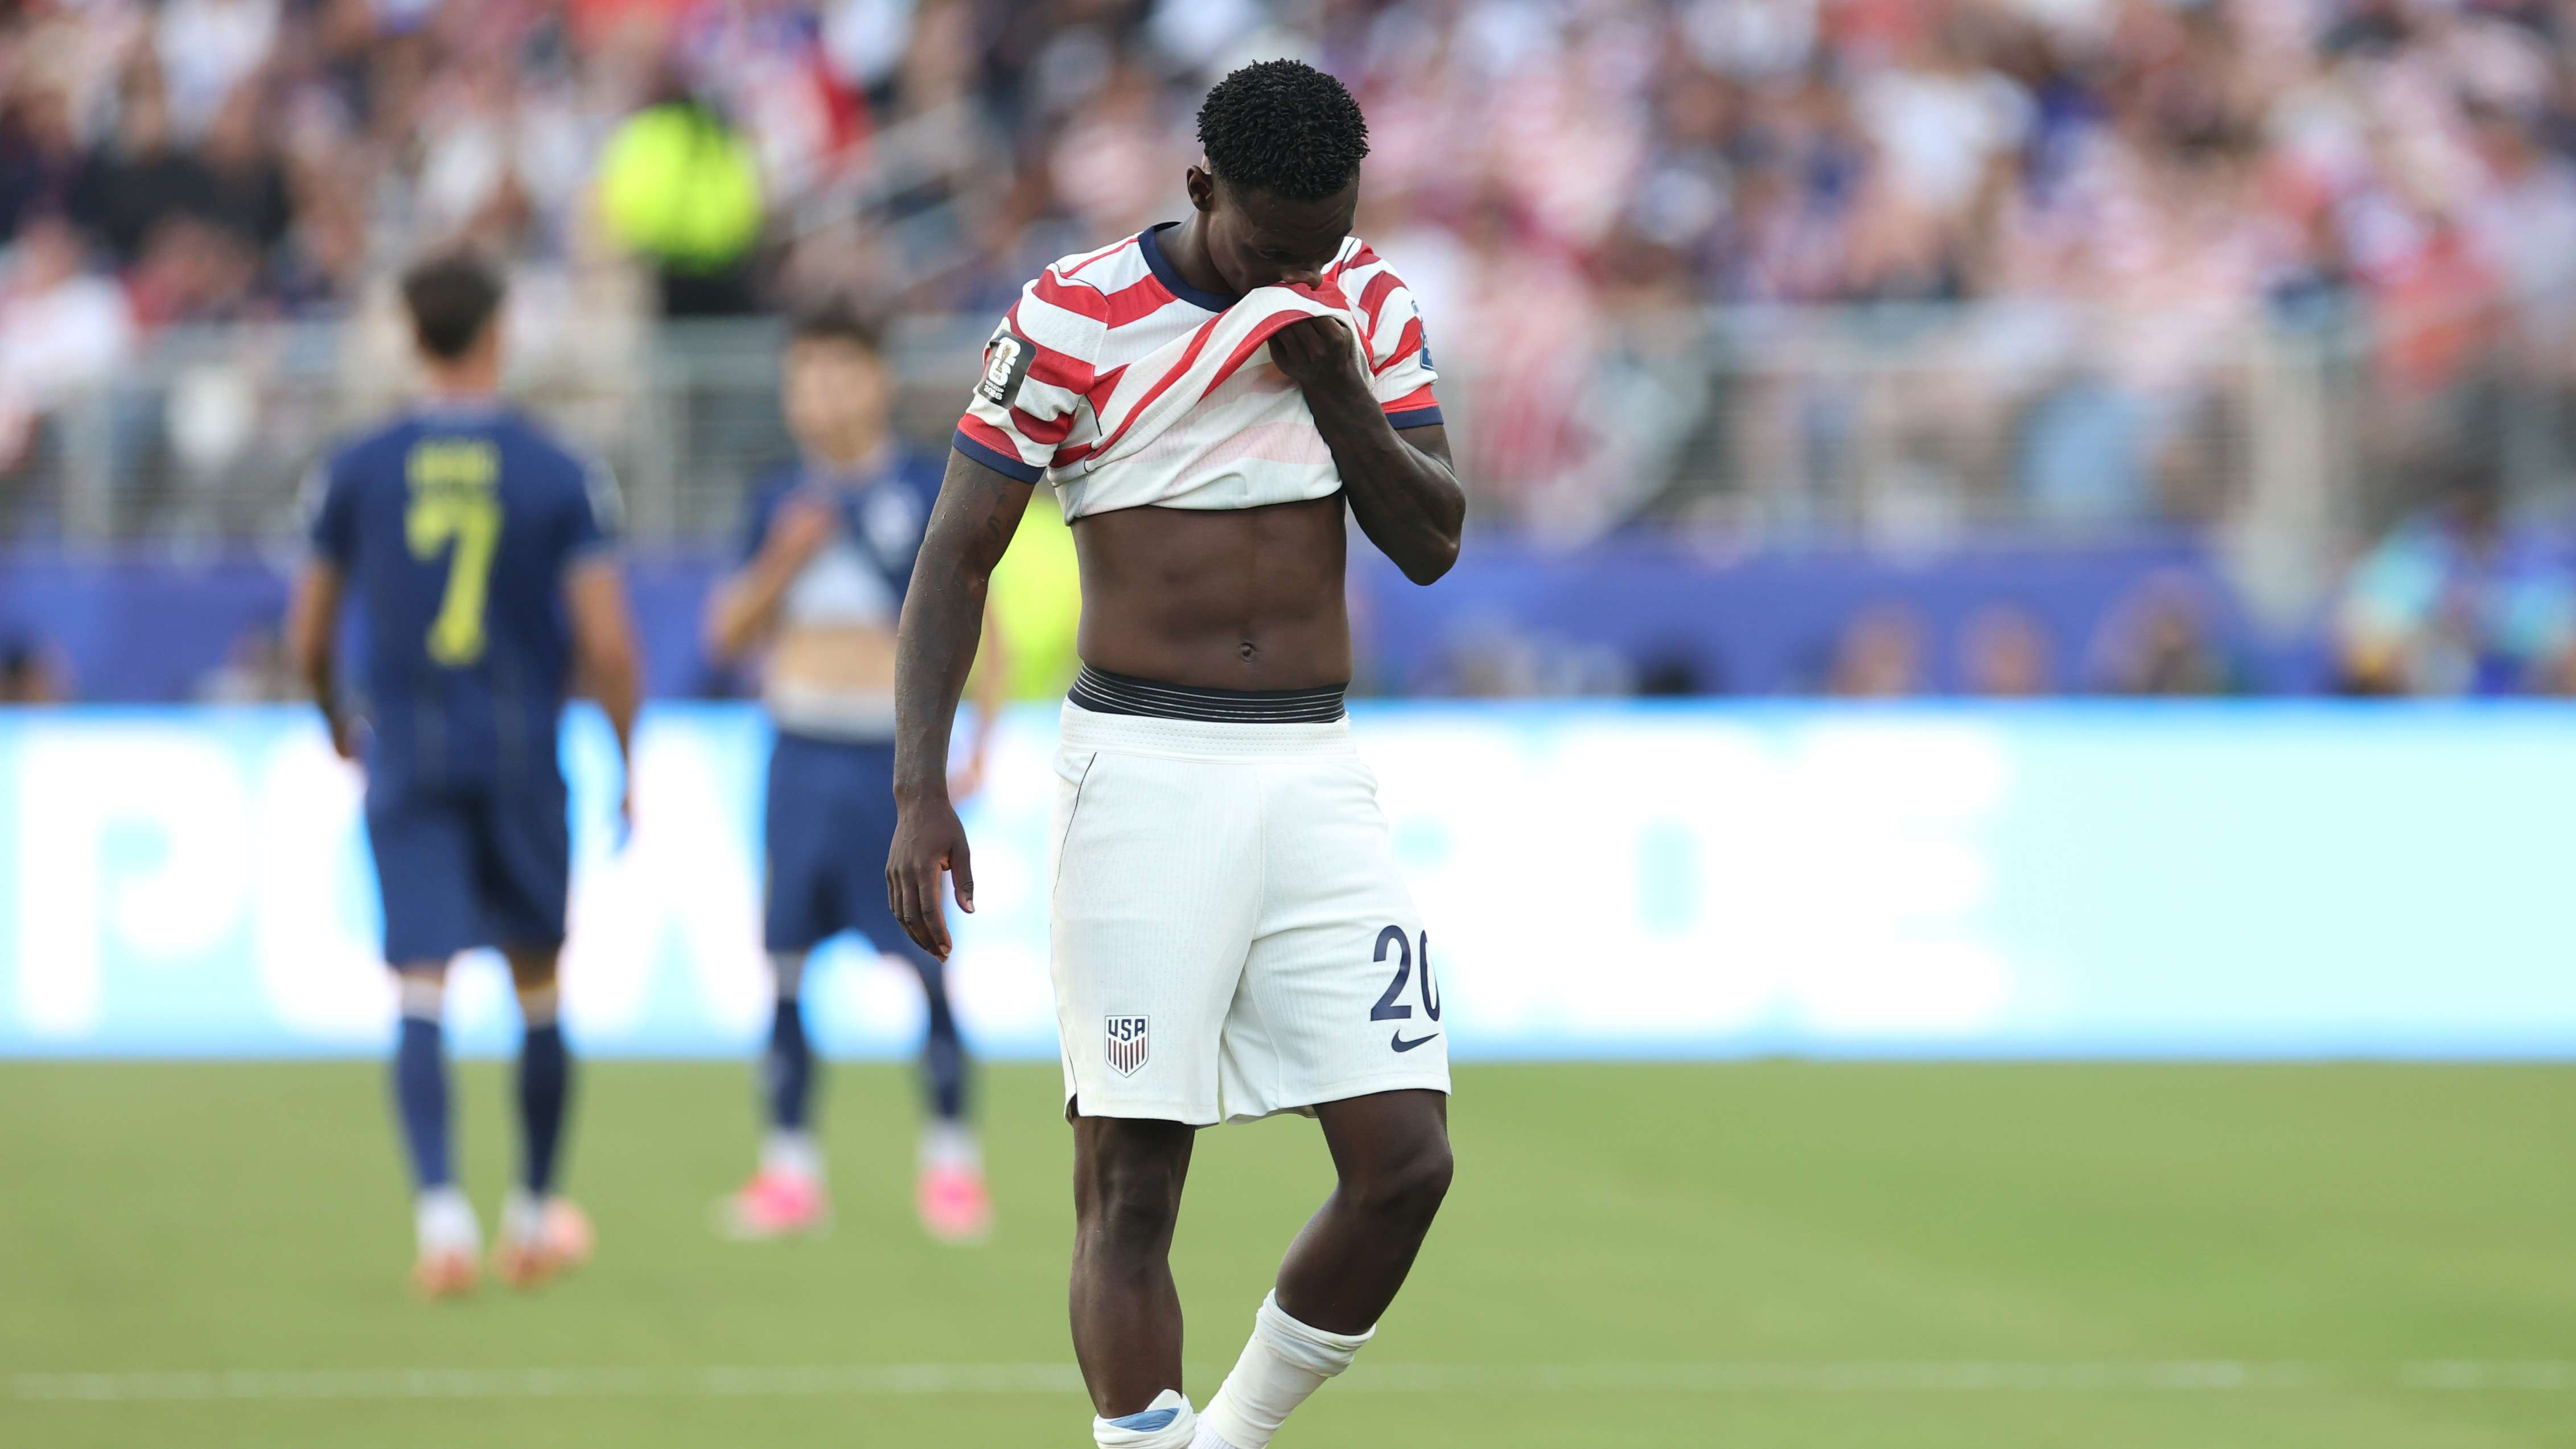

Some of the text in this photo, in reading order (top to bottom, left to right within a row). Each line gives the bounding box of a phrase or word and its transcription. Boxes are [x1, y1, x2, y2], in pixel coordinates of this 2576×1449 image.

[984, 385, 1002, 400] 2026
[405, 491, 502, 666] 7
[1370, 924, 1441, 1022] 20
[1108, 1019, 1145, 1042] USA
